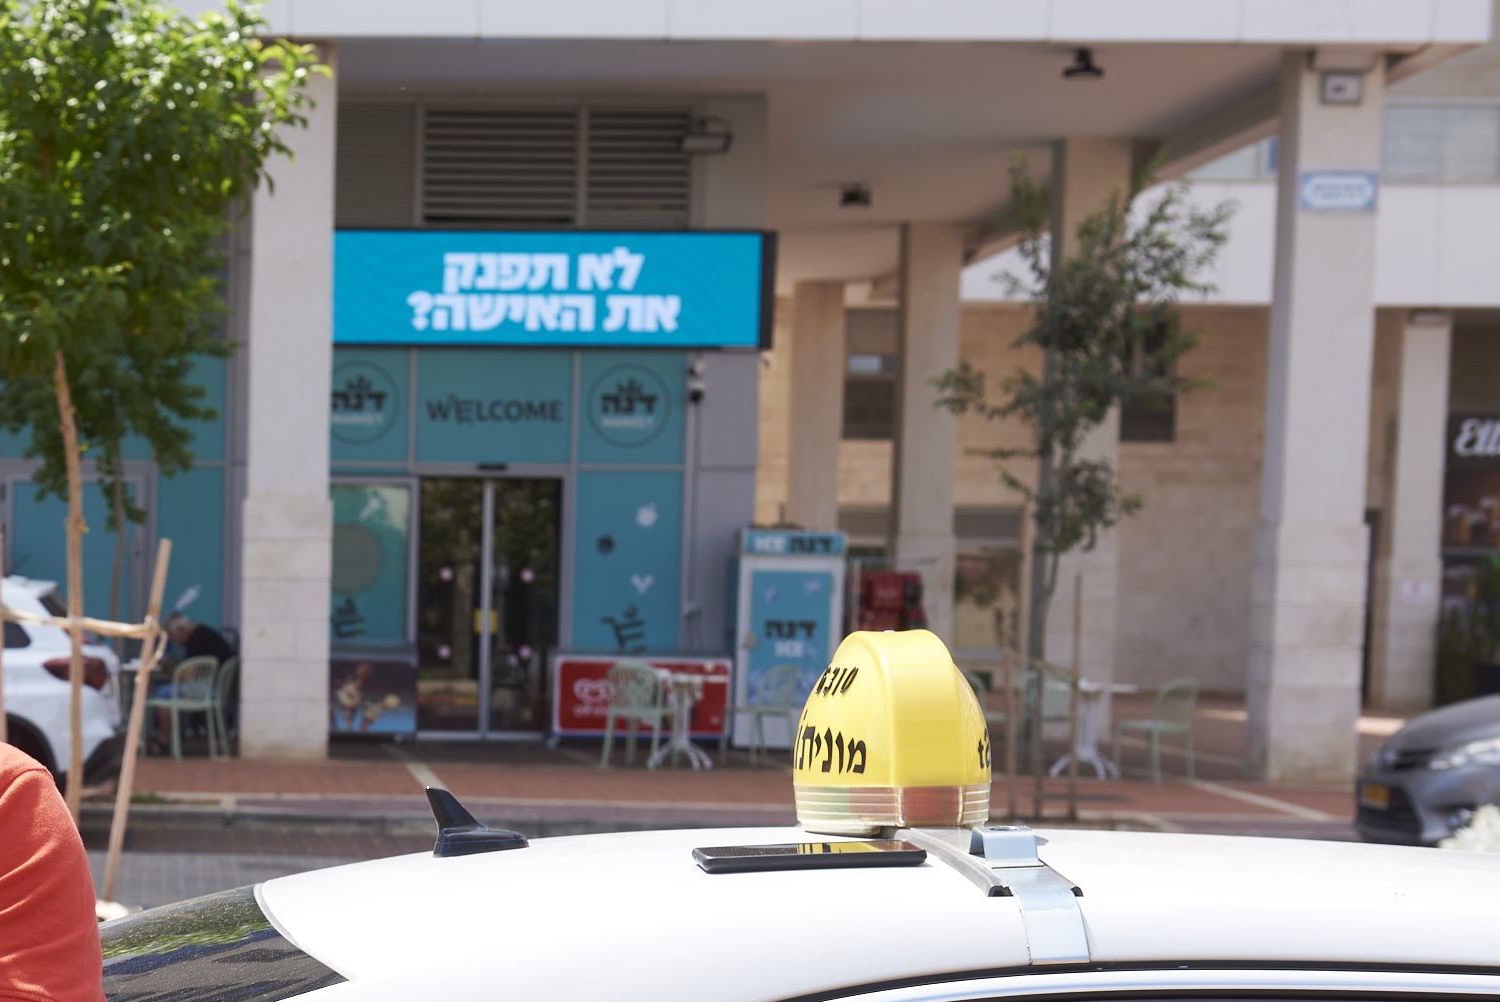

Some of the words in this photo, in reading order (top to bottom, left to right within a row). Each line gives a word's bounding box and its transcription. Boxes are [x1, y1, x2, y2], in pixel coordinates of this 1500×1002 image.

[442, 251, 570, 296] תפנק
[576, 246, 645, 291] לא
[406, 291, 595, 332] האישה?
[603, 295, 681, 332] את
[425, 393, 564, 426] WELCOME
